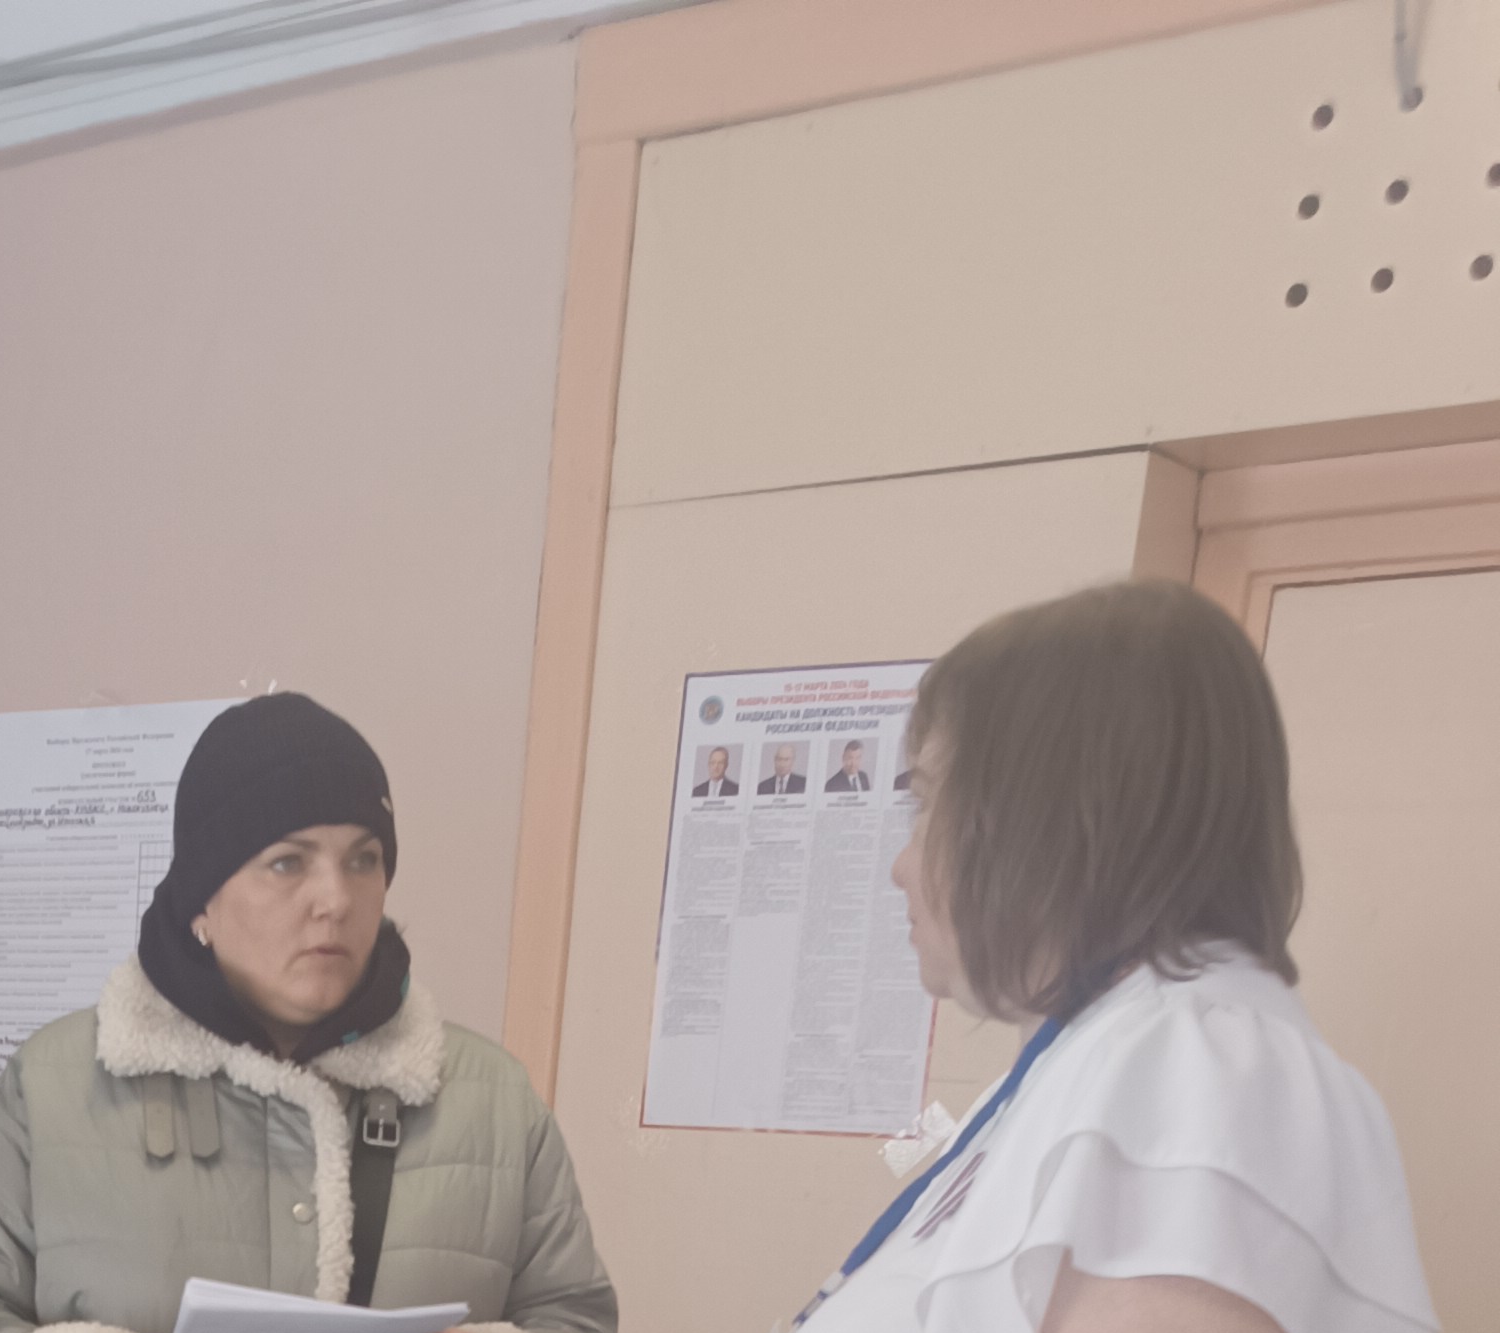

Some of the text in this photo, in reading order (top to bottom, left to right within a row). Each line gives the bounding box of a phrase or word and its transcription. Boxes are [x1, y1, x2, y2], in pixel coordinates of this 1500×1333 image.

[735, 709, 788, 722] КАНДИДАТЫ
[789, 709, 801, 719] НА
[802, 706, 855, 719] ДОЛЖНОСТЬ
[765, 719, 879, 735] РОССИЙСКОЙ ФЕДЕРАЦИИ
